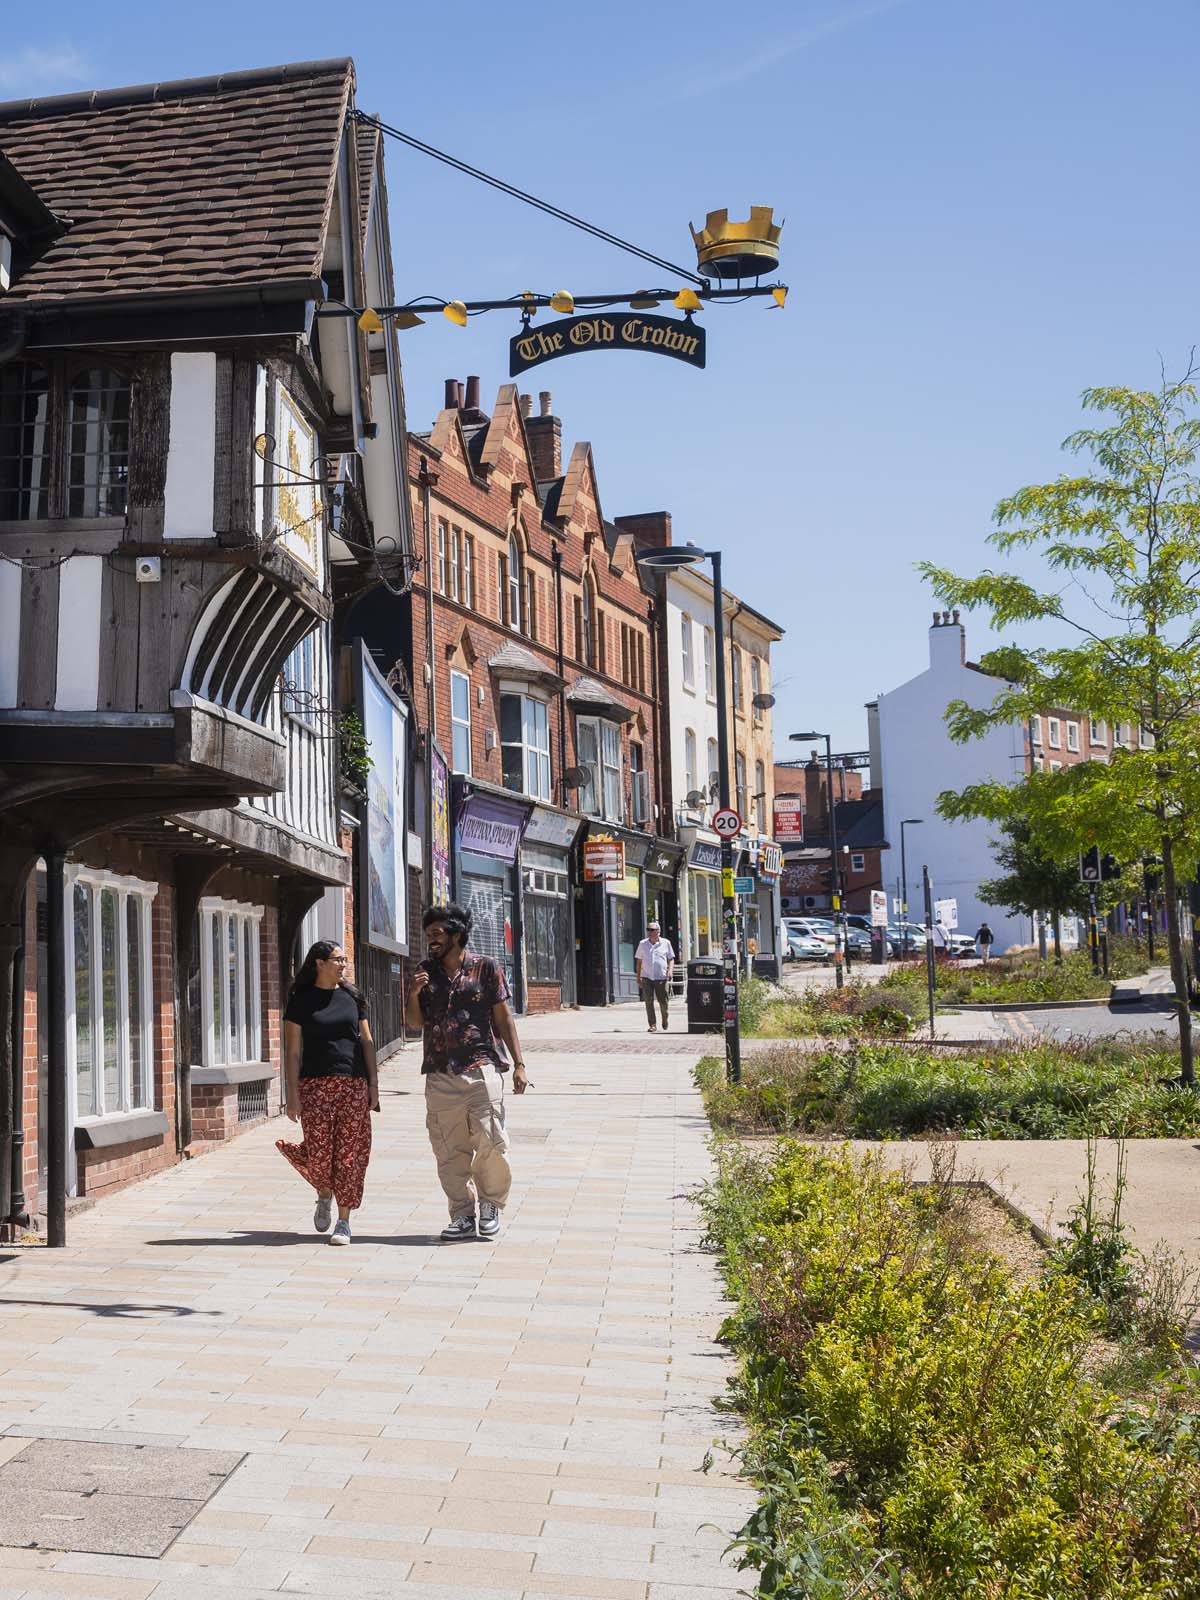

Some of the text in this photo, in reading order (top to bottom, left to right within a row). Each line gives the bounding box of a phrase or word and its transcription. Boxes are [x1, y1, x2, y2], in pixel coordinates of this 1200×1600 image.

[516, 319, 700, 361] The Old Crown
[717, 817, 737, 829] 20
